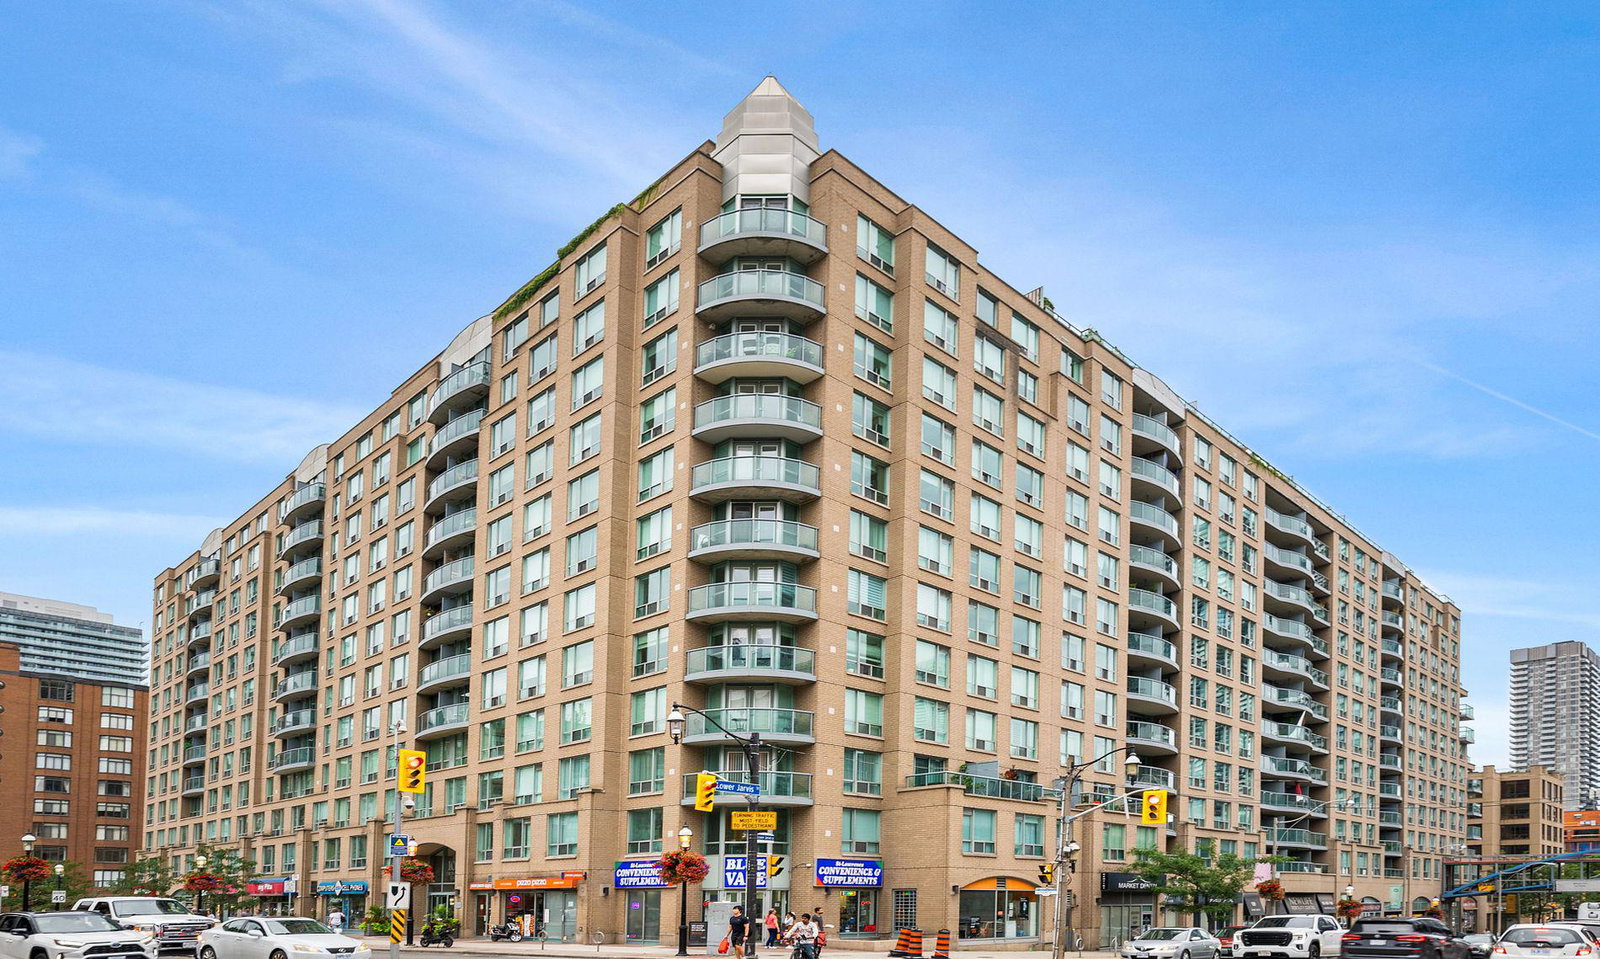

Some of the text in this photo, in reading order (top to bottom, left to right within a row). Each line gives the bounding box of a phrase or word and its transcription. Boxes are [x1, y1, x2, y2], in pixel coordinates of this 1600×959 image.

[716, 782, 734, 791] Lower
[737, 784, 754, 793] Jarvis
[726, 858, 766, 869] BLE
[616, 868, 662, 877] CONVENIENC
[818, 867, 873, 876] CONVENIENCE
[725, 871, 766, 885] VAE
[823, 876, 879, 885] SUPPLEMENTS
